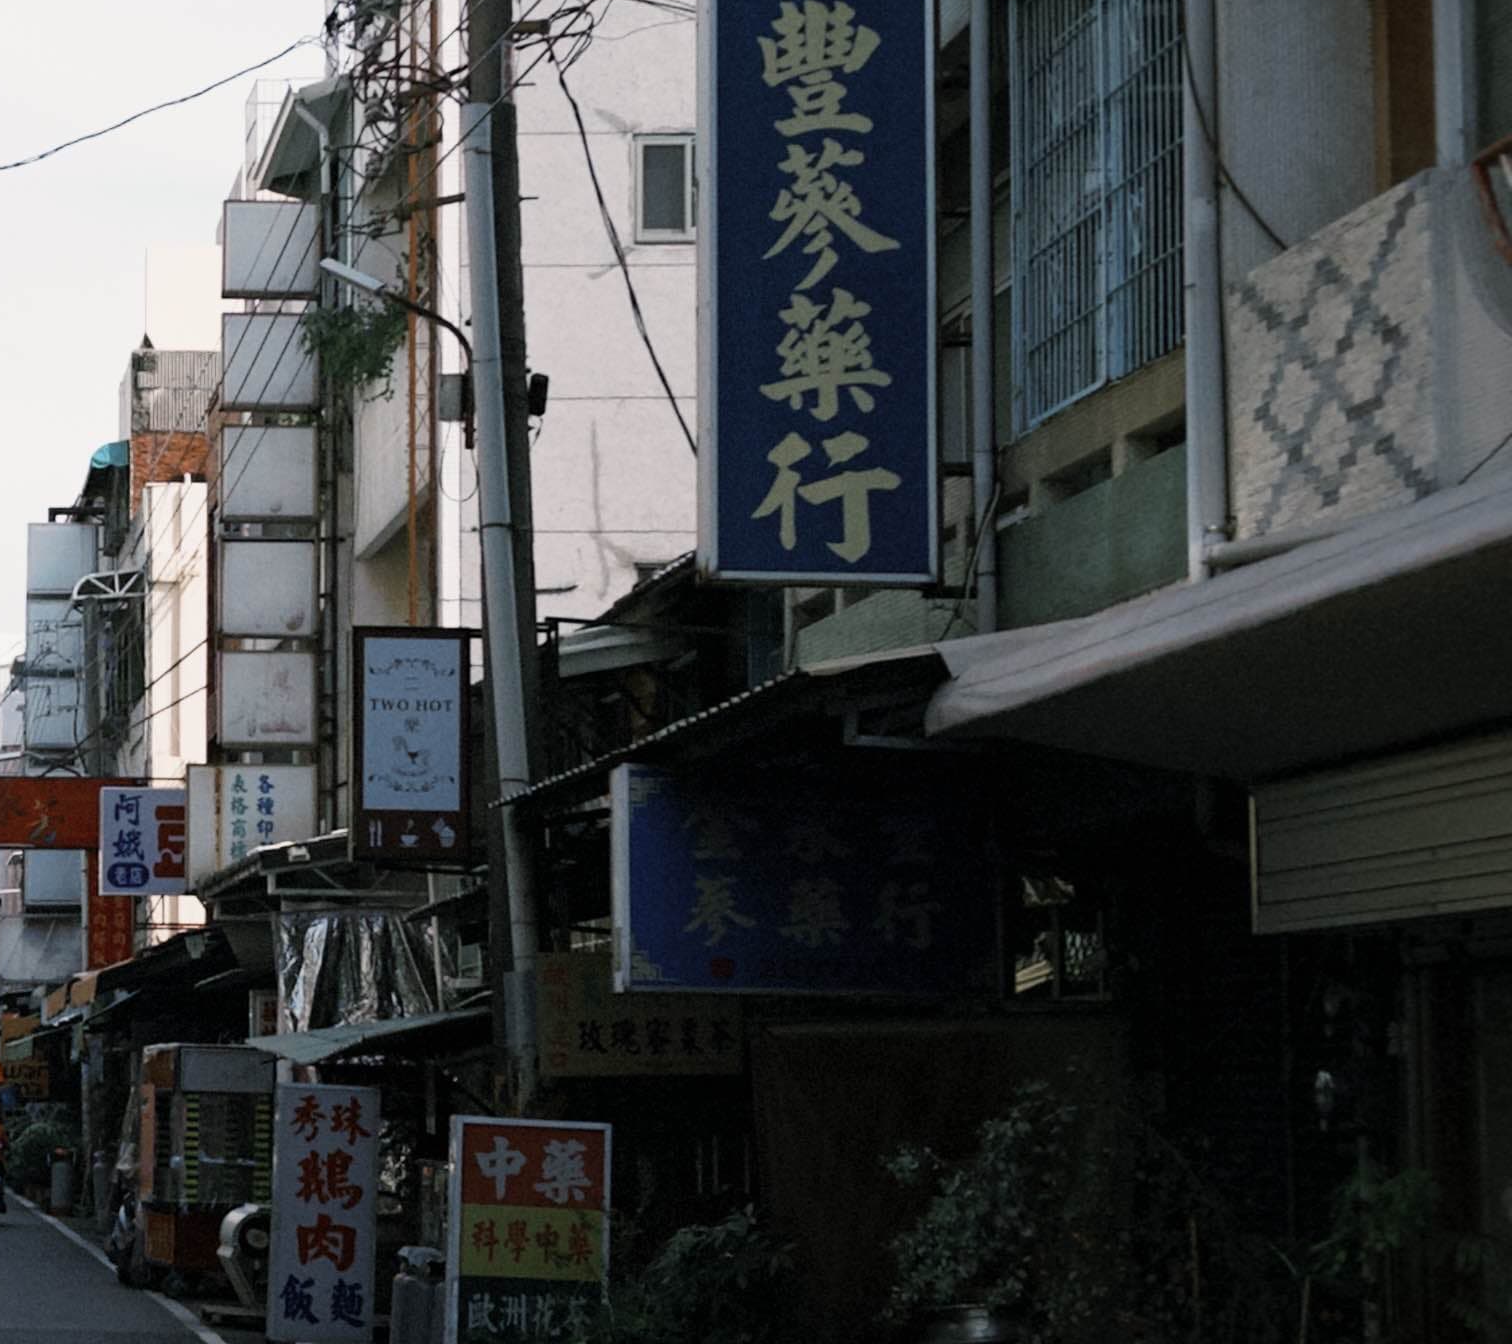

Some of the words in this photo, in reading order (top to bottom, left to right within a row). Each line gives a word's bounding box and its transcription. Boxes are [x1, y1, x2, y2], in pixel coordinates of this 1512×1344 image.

[369, 698, 409, 712] TWO
[415, 698, 453, 712] HOT
[257, 774, 274, 845] 各種印
[474, 1135, 592, 1204] 中藥
[471, 1219, 593, 1265] 科學中藥
